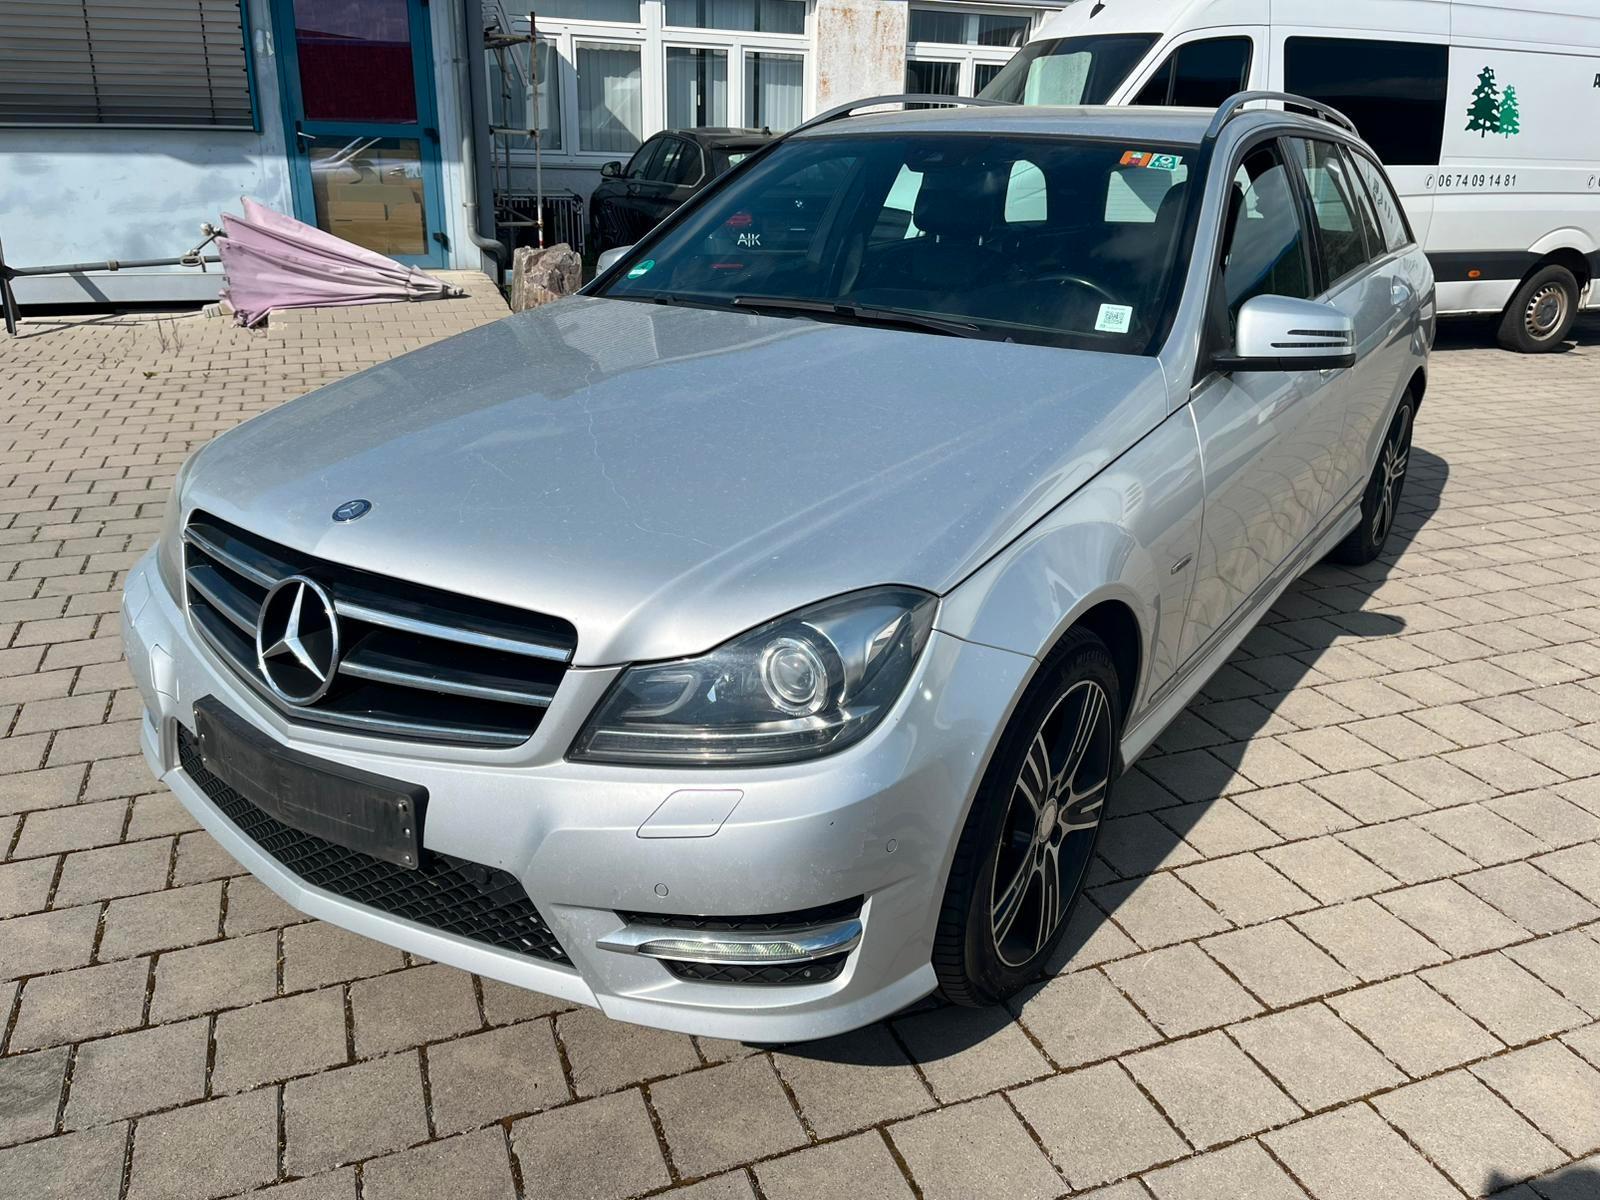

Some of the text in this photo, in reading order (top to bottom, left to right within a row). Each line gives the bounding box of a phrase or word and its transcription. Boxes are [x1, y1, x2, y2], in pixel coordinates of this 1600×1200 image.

[1438, 174, 1516, 187] 06 74 09 14 81
